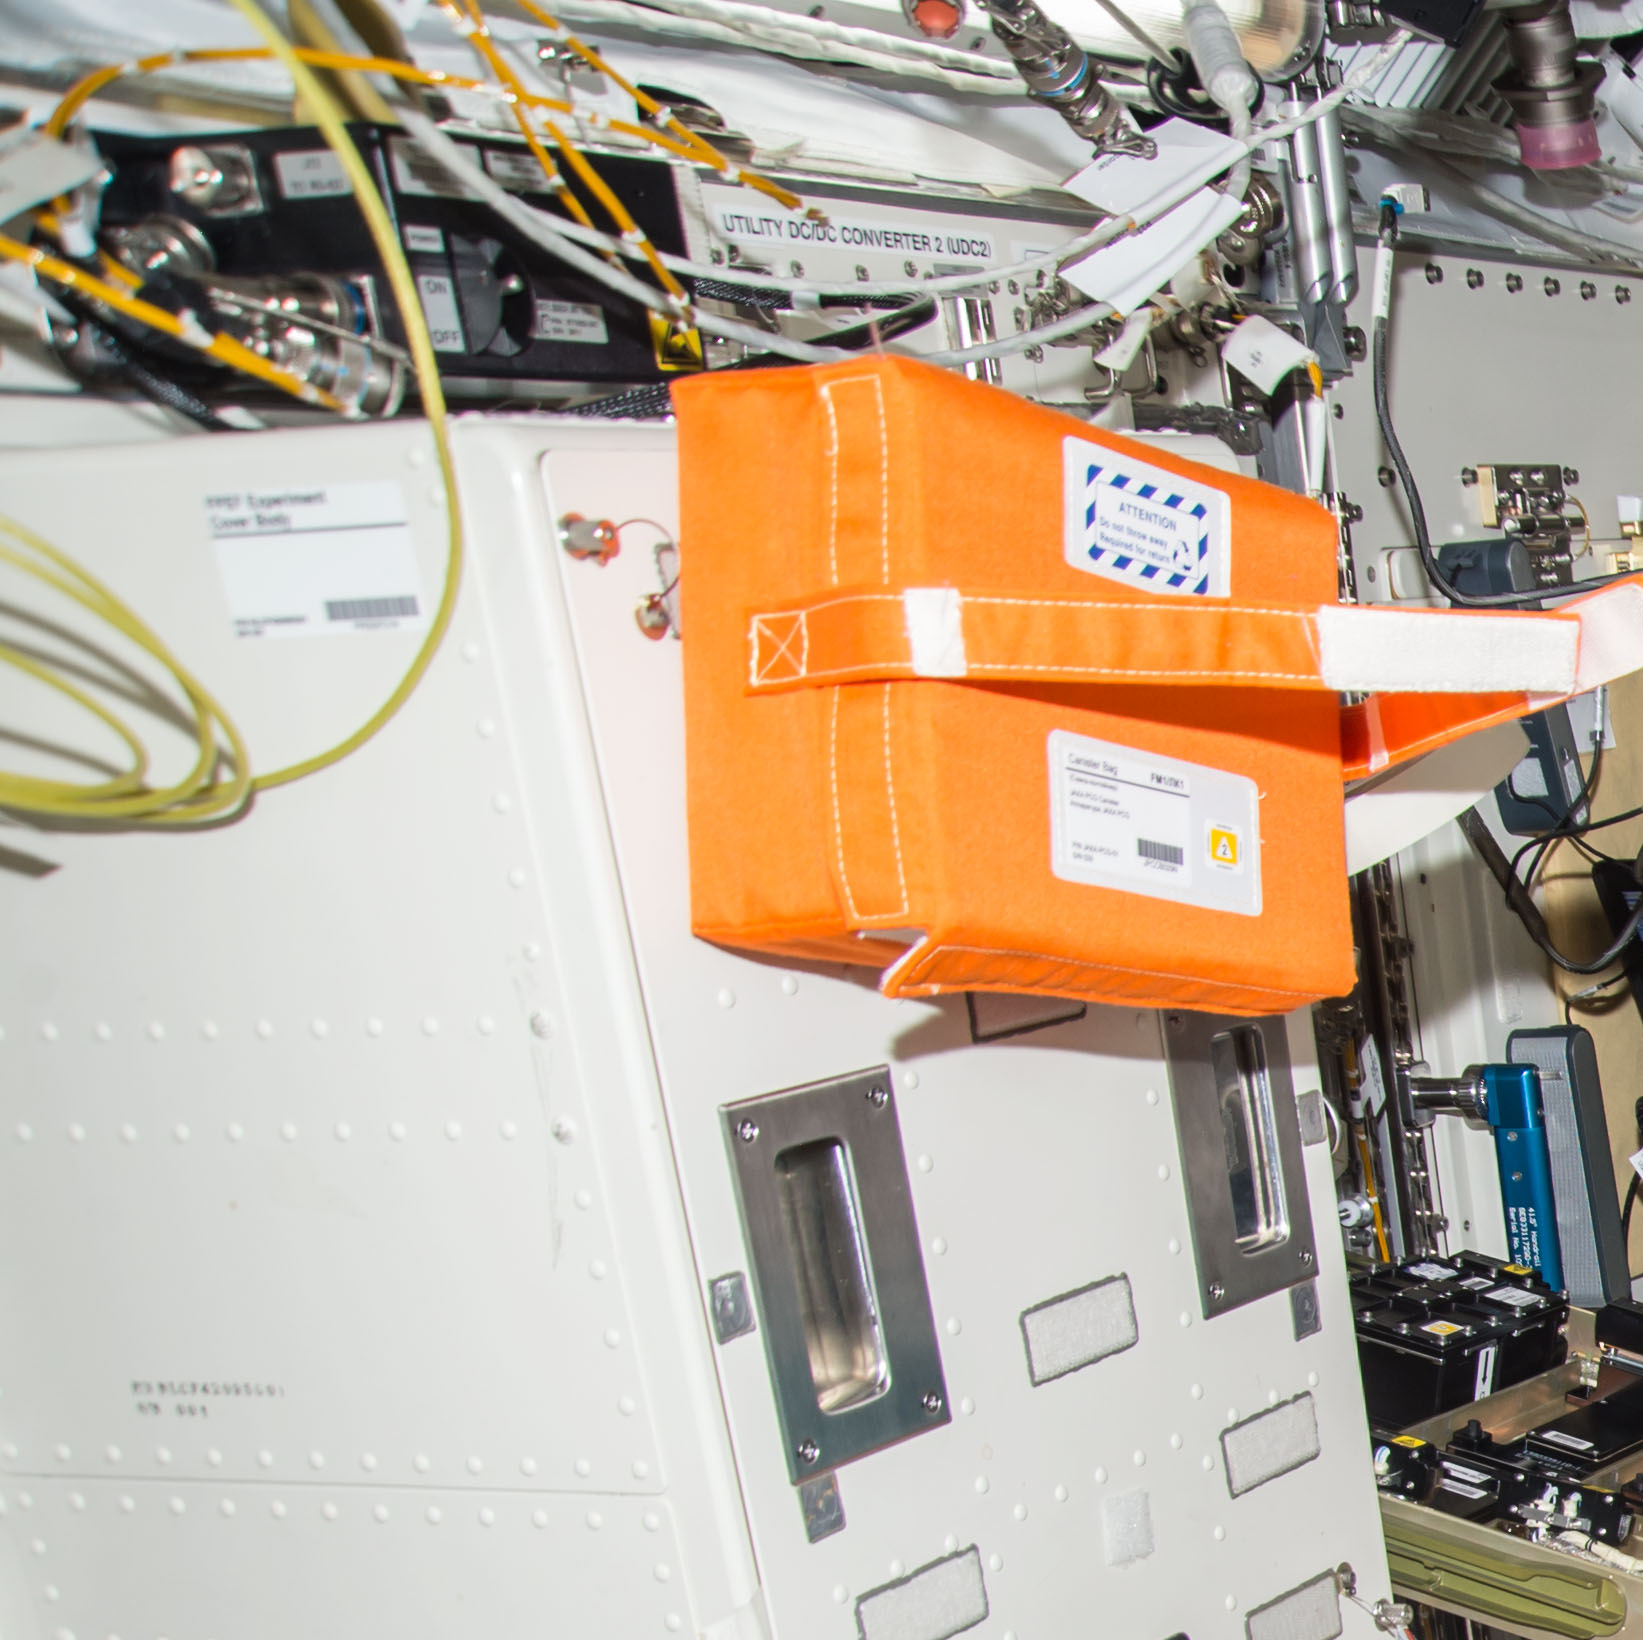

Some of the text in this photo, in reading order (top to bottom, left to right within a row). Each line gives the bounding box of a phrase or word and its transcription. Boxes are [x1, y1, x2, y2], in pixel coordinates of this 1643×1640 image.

[722, 214, 992, 258] UTILITY DC/DC CONVERTER 2 (UDC2)
[425, 279, 449, 294] ON
[432, 330, 460, 344] OFF
[1119, 501, 1177, 532] ATTENTION
[1100, 531, 1133, 551] Required
[1147, 549, 1170, 563] return
[1112, 520, 1124, 533] not
[1126, 525, 1147, 540] throw
[1149, 533, 1168, 550] away
[1508, 1206, 1519, 1234] Serial
